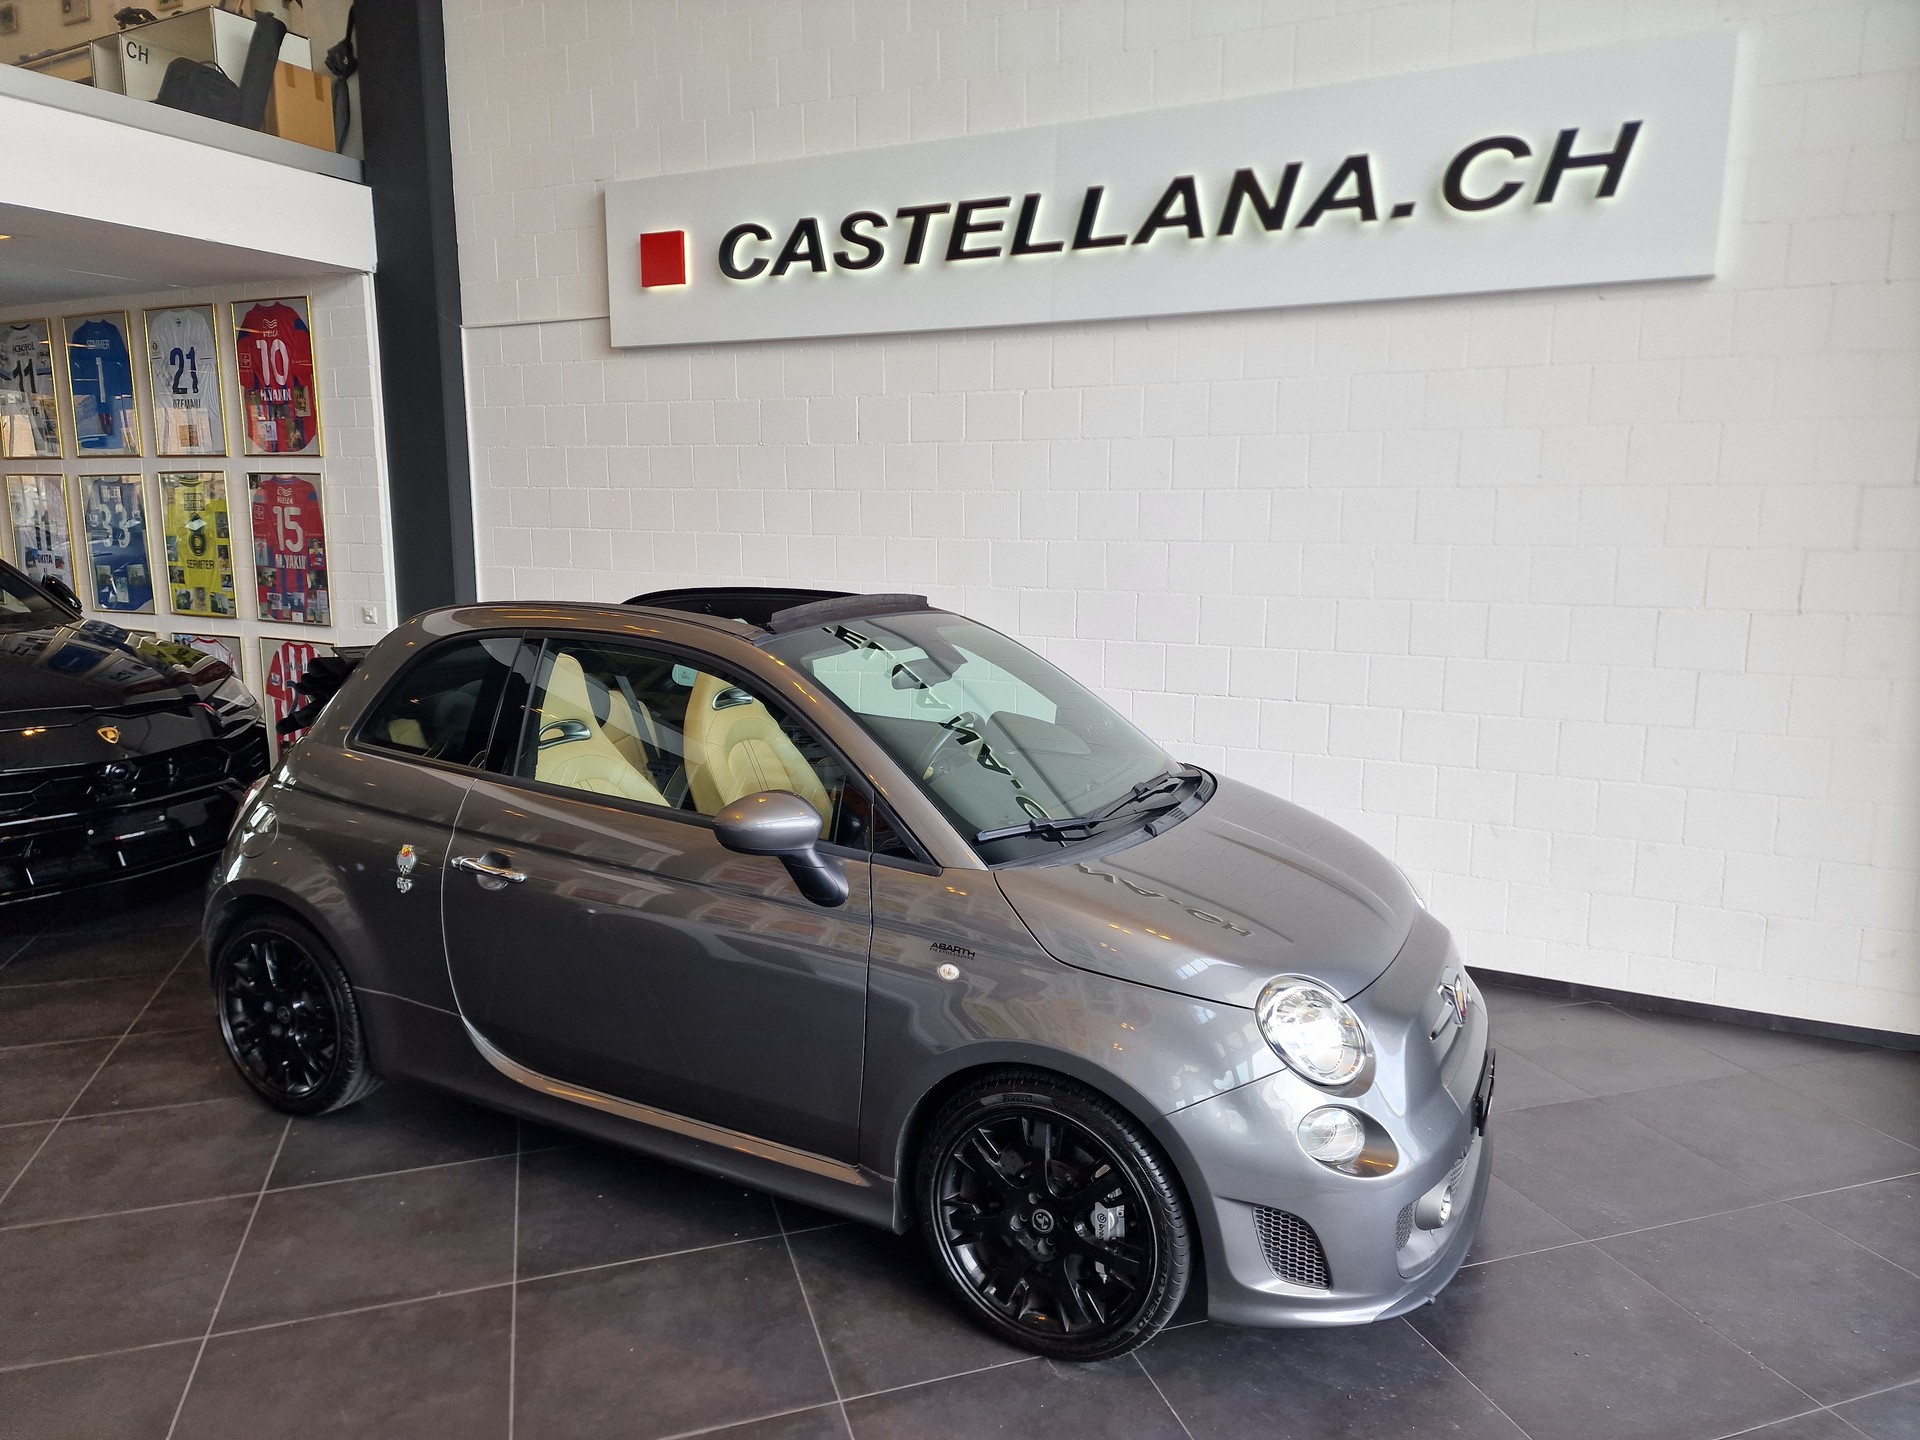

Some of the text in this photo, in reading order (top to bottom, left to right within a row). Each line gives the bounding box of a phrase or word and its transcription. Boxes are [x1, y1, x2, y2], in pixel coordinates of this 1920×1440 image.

[126, 41, 149, 65] CH
[718, 119, 1643, 281] CASTELLANA.CH
[12, 358, 37, 394] 11
[95, 356, 106, 403] 1
[170, 346, 199, 395] 21
[256, 338, 289, 386] 10
[272, 505, 304, 553] 15
[930, 942, 976, 957] ABARTH
